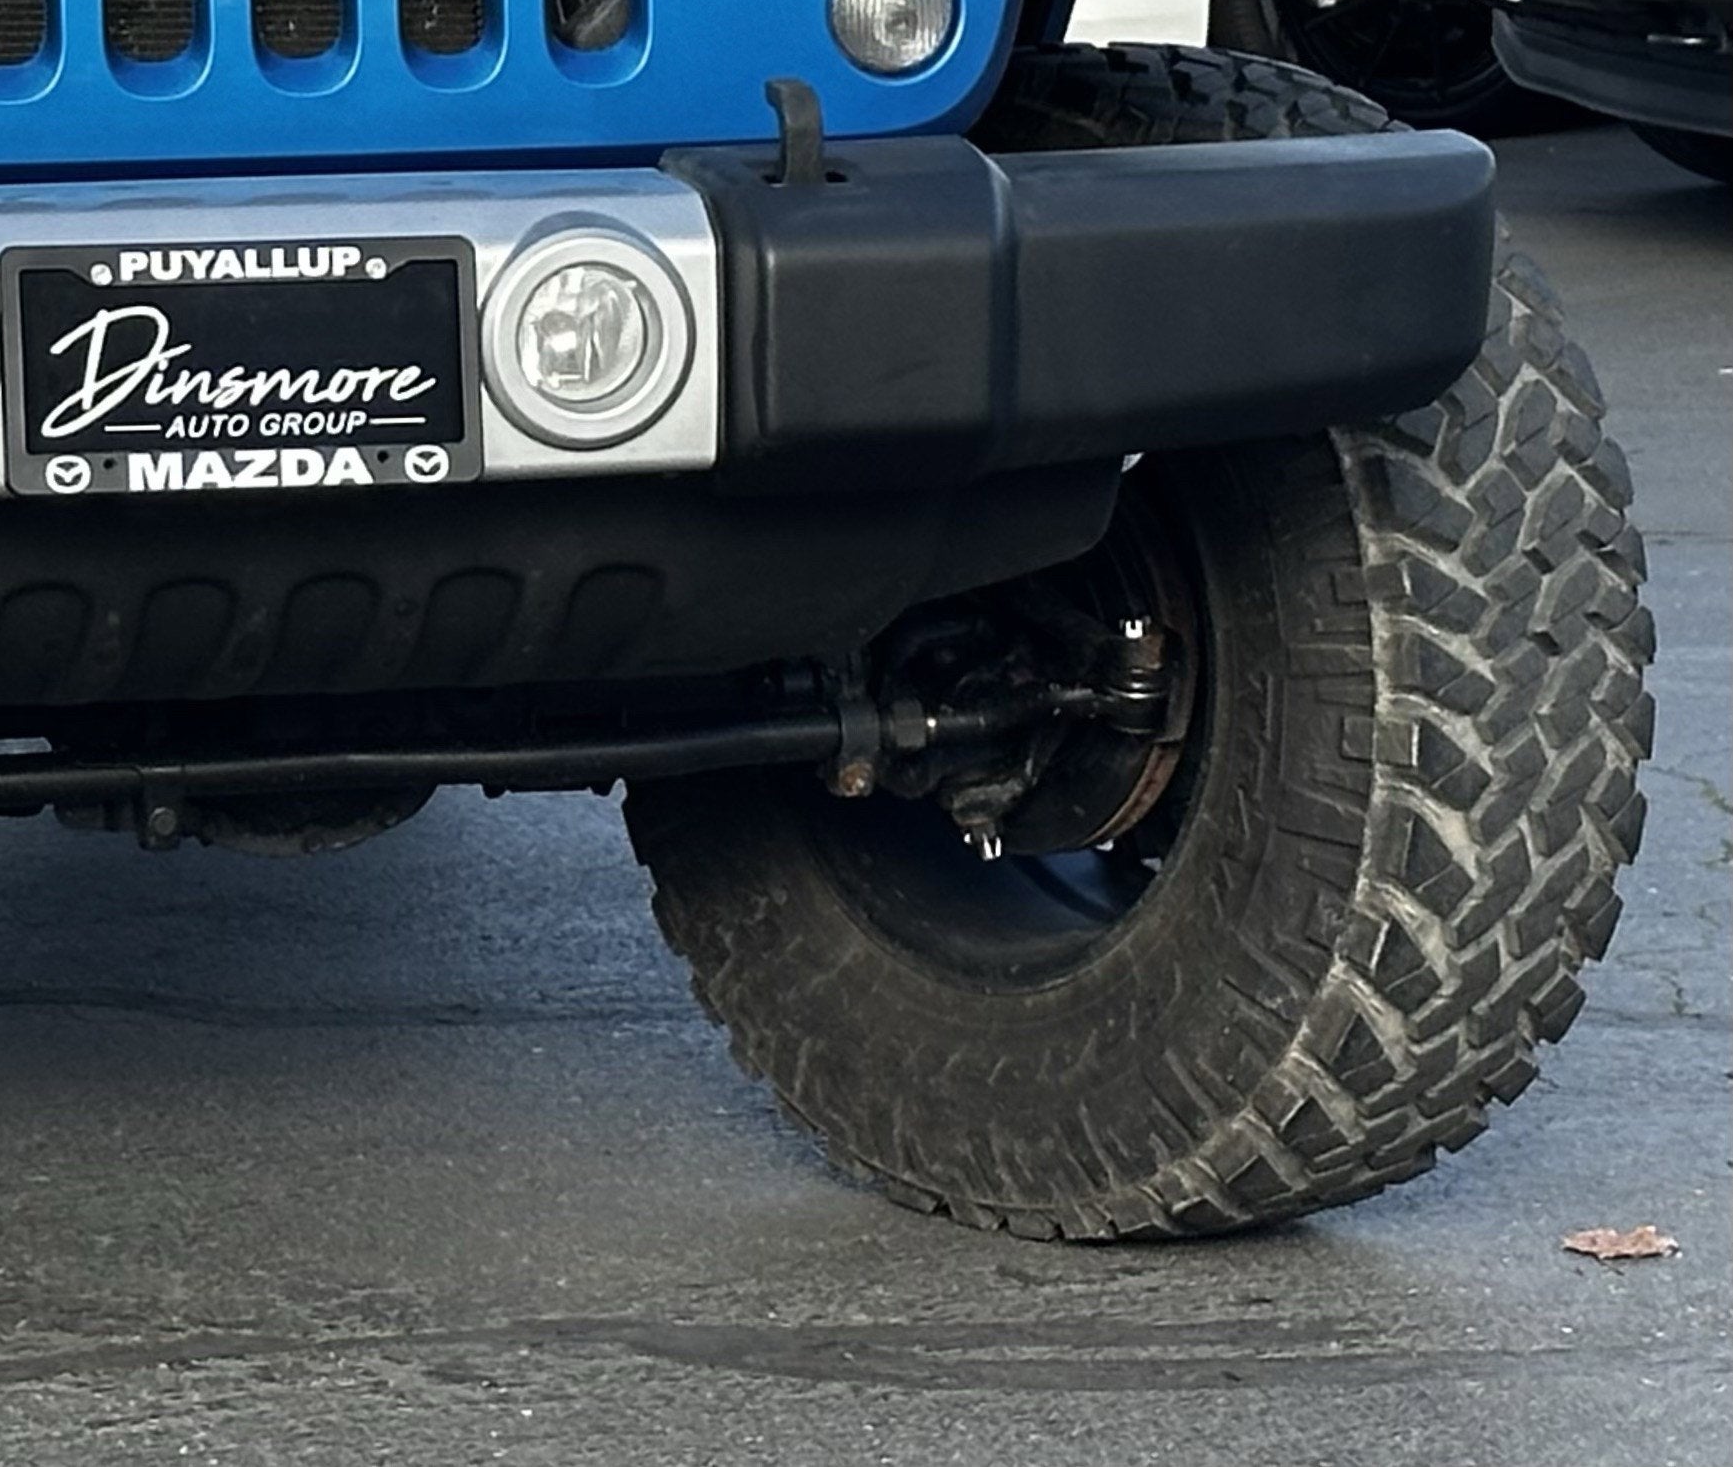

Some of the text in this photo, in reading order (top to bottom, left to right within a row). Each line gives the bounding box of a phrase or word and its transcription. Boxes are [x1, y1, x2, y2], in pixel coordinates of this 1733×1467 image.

[119, 246, 360, 281] PUYALLUP
[41, 306, 436, 438] Dinsmore
[165, 411, 367, 439] AUTO GROUP
[128, 447, 374, 491] MAZDA
